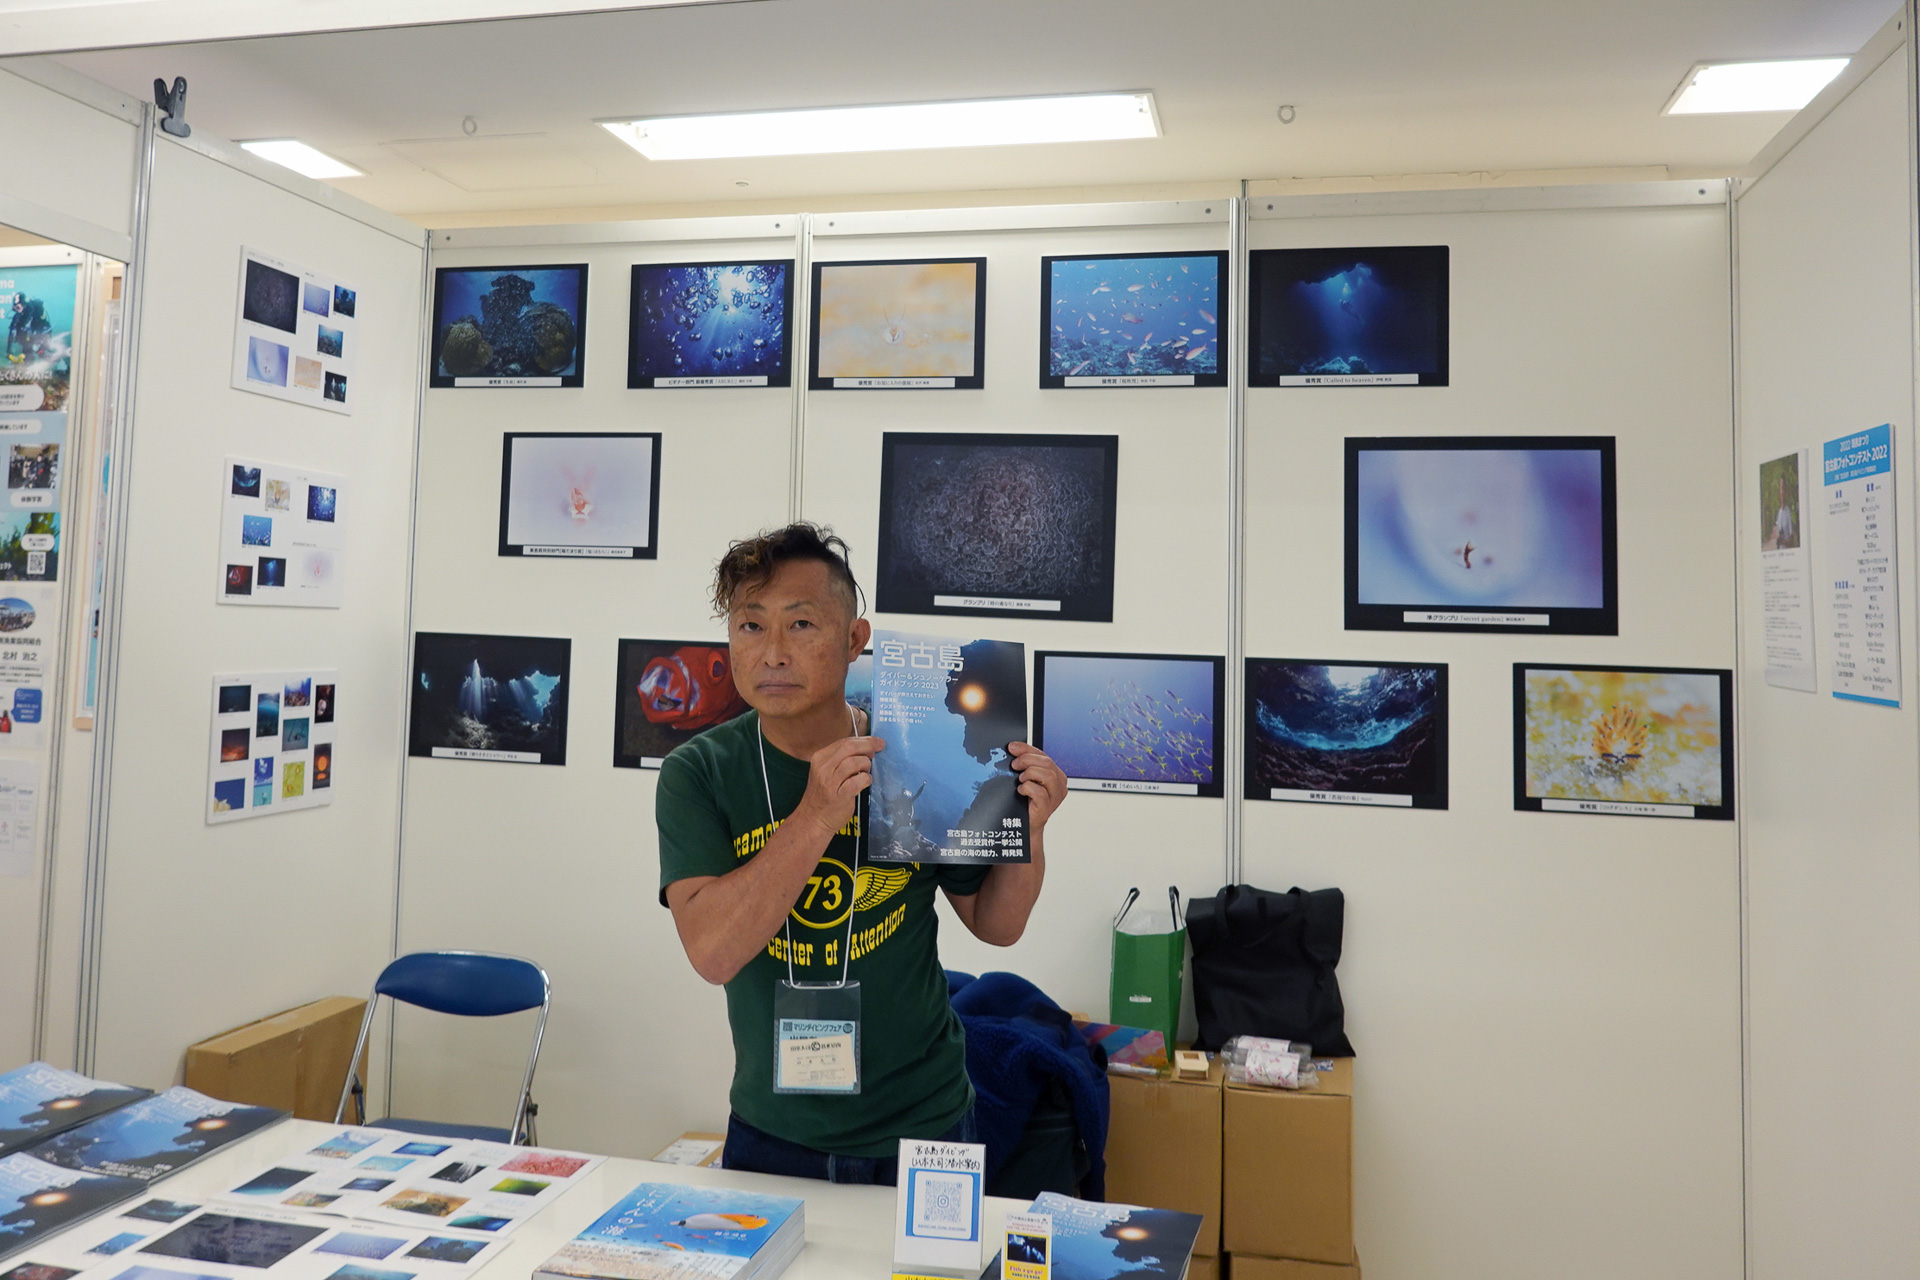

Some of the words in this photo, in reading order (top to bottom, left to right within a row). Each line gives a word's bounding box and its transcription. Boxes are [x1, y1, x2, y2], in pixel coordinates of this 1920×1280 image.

[880, 639, 965, 672] 宮古島
[879, 679, 920, 688] ガイドブック
[921, 682, 940, 690] 2023
[1002, 817, 1022, 828] 特集
[946, 829, 1022, 838] 宮古島フォトコンテスト
[803, 874, 843, 911] 73
[825, 939, 838, 966] of
[850, 903, 906, 960] Attention
[793, 1023, 842, 1032] マリンダイビングフェア
